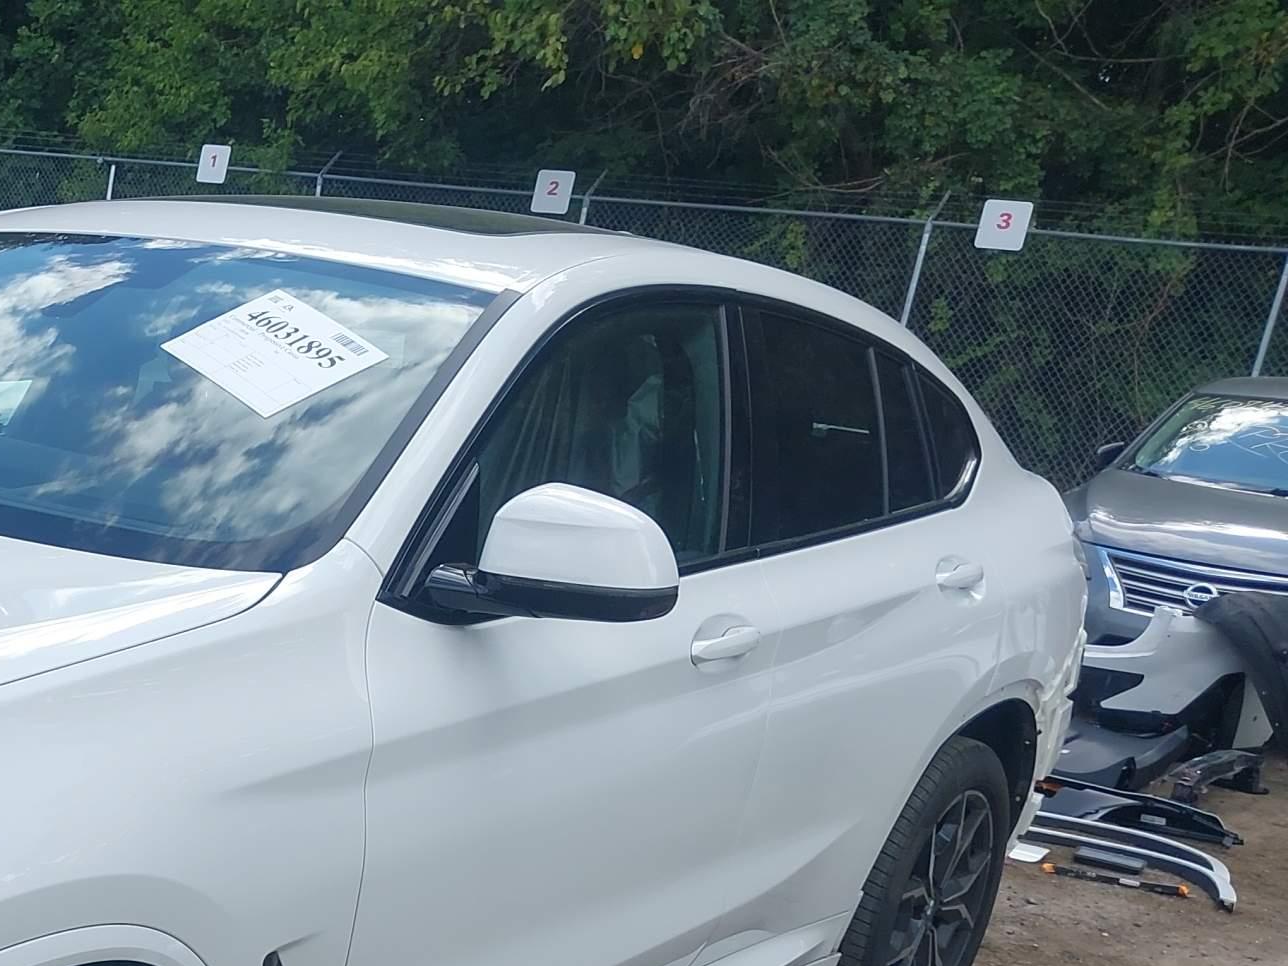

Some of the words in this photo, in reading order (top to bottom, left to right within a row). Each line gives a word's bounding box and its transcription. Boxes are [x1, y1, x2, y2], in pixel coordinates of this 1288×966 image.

[211, 155, 217, 167] 1
[546, 180, 560, 196] 2
[996, 212, 1013, 230] 3
[247, 310, 346, 369] 46031895
